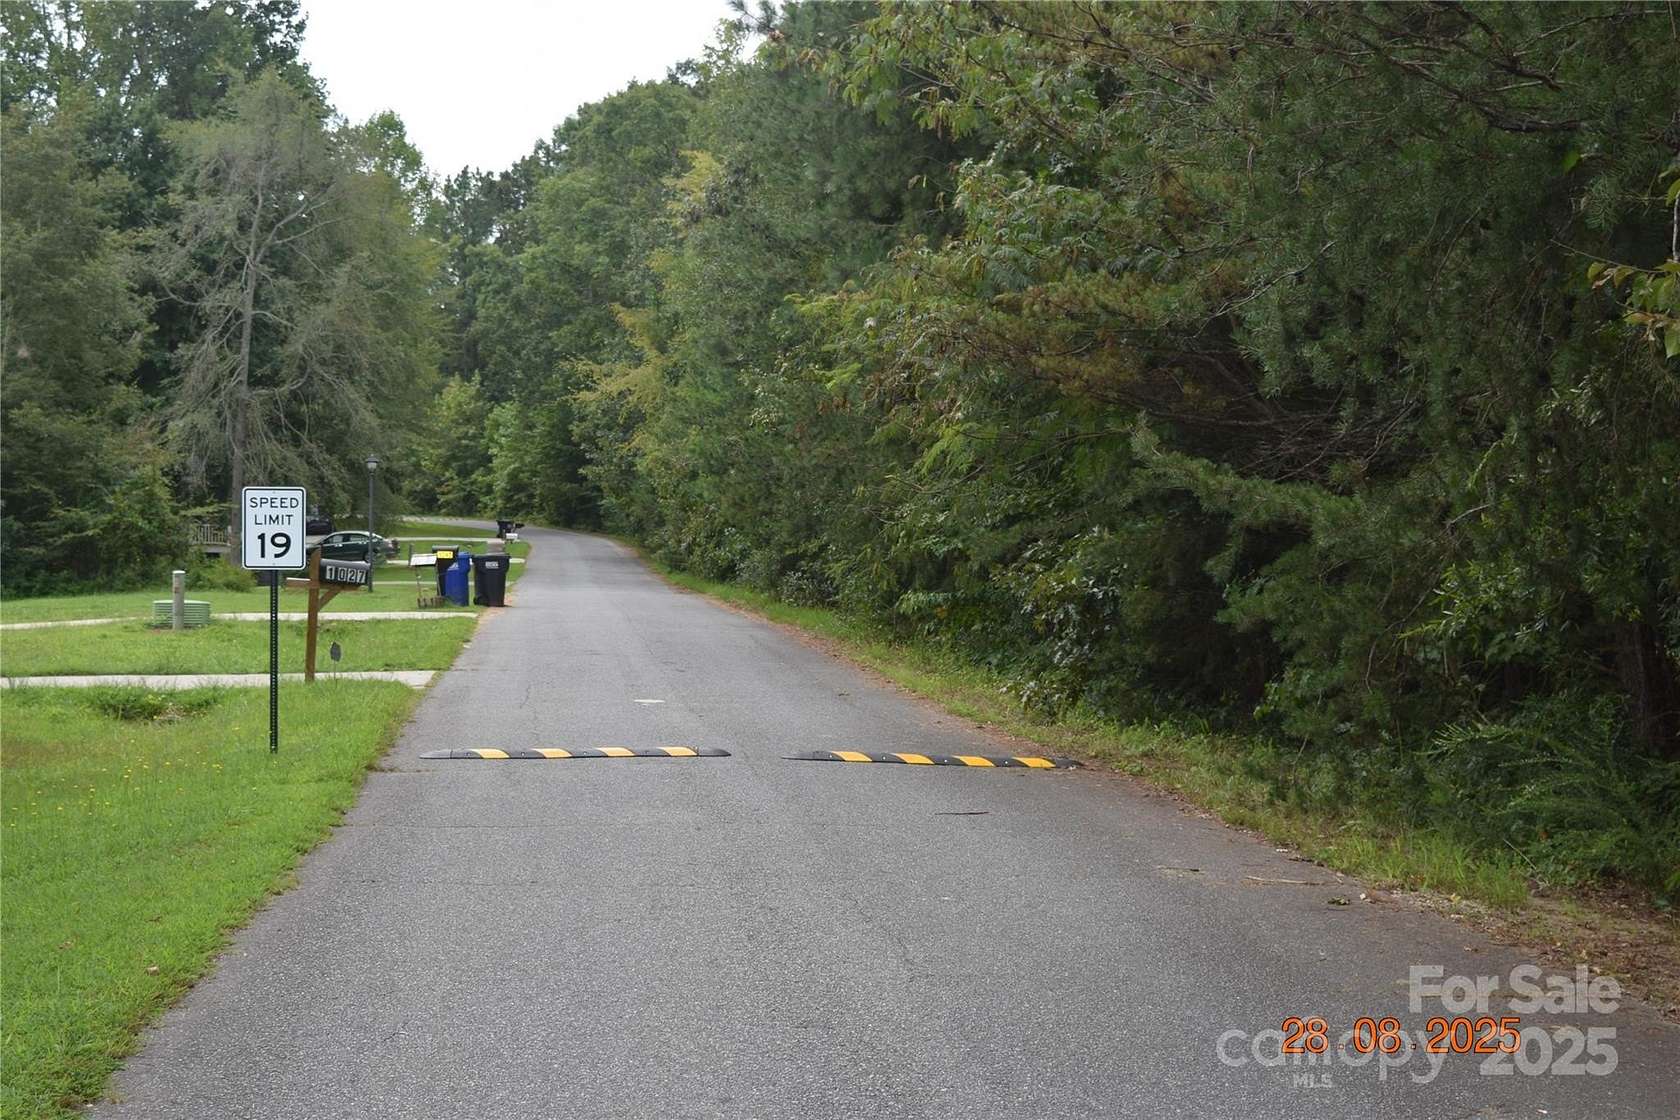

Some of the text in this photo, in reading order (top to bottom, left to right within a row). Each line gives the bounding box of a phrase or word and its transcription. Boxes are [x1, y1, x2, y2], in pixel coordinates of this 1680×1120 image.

[250, 497, 299, 508] SPEED
[254, 514, 294, 525] LIMIT
[257, 532, 291, 558] 19
[326, 566, 366, 583] 1027
